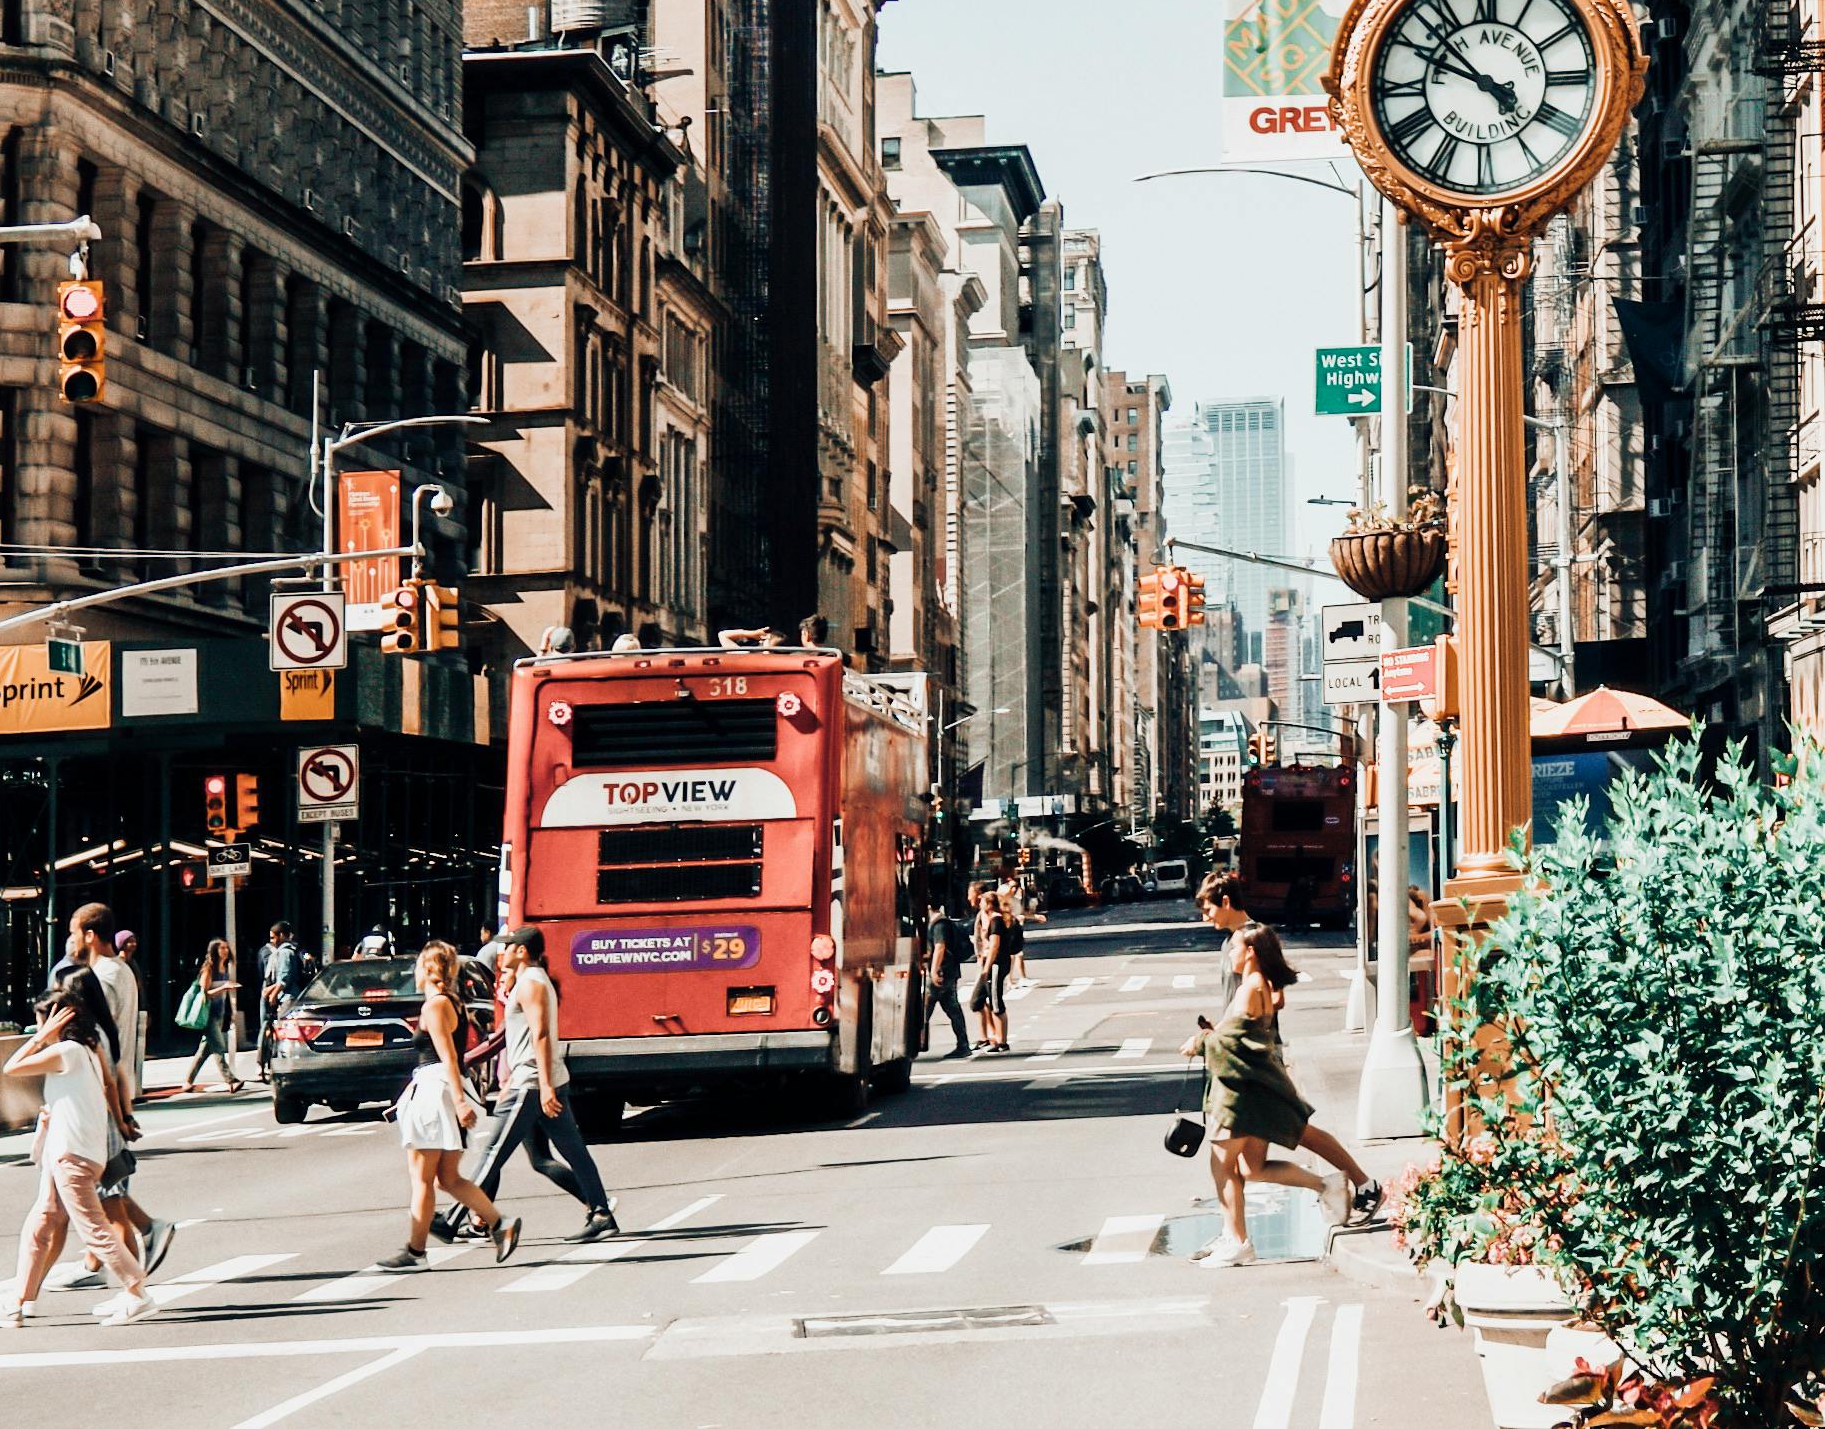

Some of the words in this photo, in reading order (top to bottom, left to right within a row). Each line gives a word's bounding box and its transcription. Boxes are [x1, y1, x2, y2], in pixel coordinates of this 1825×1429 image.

[1479, 29, 1541, 79] AVENUE
[1442, 106, 1532, 140] BUILDING
[1321, 352, 1363, 368] West
[1326, 370, 1381, 389] Highw
[1367, 614, 1380, 626] TR
[1368, 633, 1381, 645] RO
[1383, 657, 1394, 666] NO
[1394, 652, 1430, 665] STANDING
[1383, 667, 1413, 679] Anytime
[285, 669, 319, 696] Sprint
[1328, 676, 1363, 689] LOCAL
[1407, 746, 1434, 762] SAB
[1531, 761, 1575, 778] RIEZE
[1407, 785, 1440, 799] SABR
[301, 810, 327, 819] EXCEPT
[330, 808, 354, 818] BUSES
[608, 805, 668, 815] SIGHTSEEING
[681, 804, 702, 812] NEW
[705, 802, 730, 811] YORK
[591, 938, 617, 950] BUY
[619, 937, 671, 950] TICKETS
[672, 937, 691, 948] AT
[576, 951, 691, 965] TOPVIEWNYC.COM
